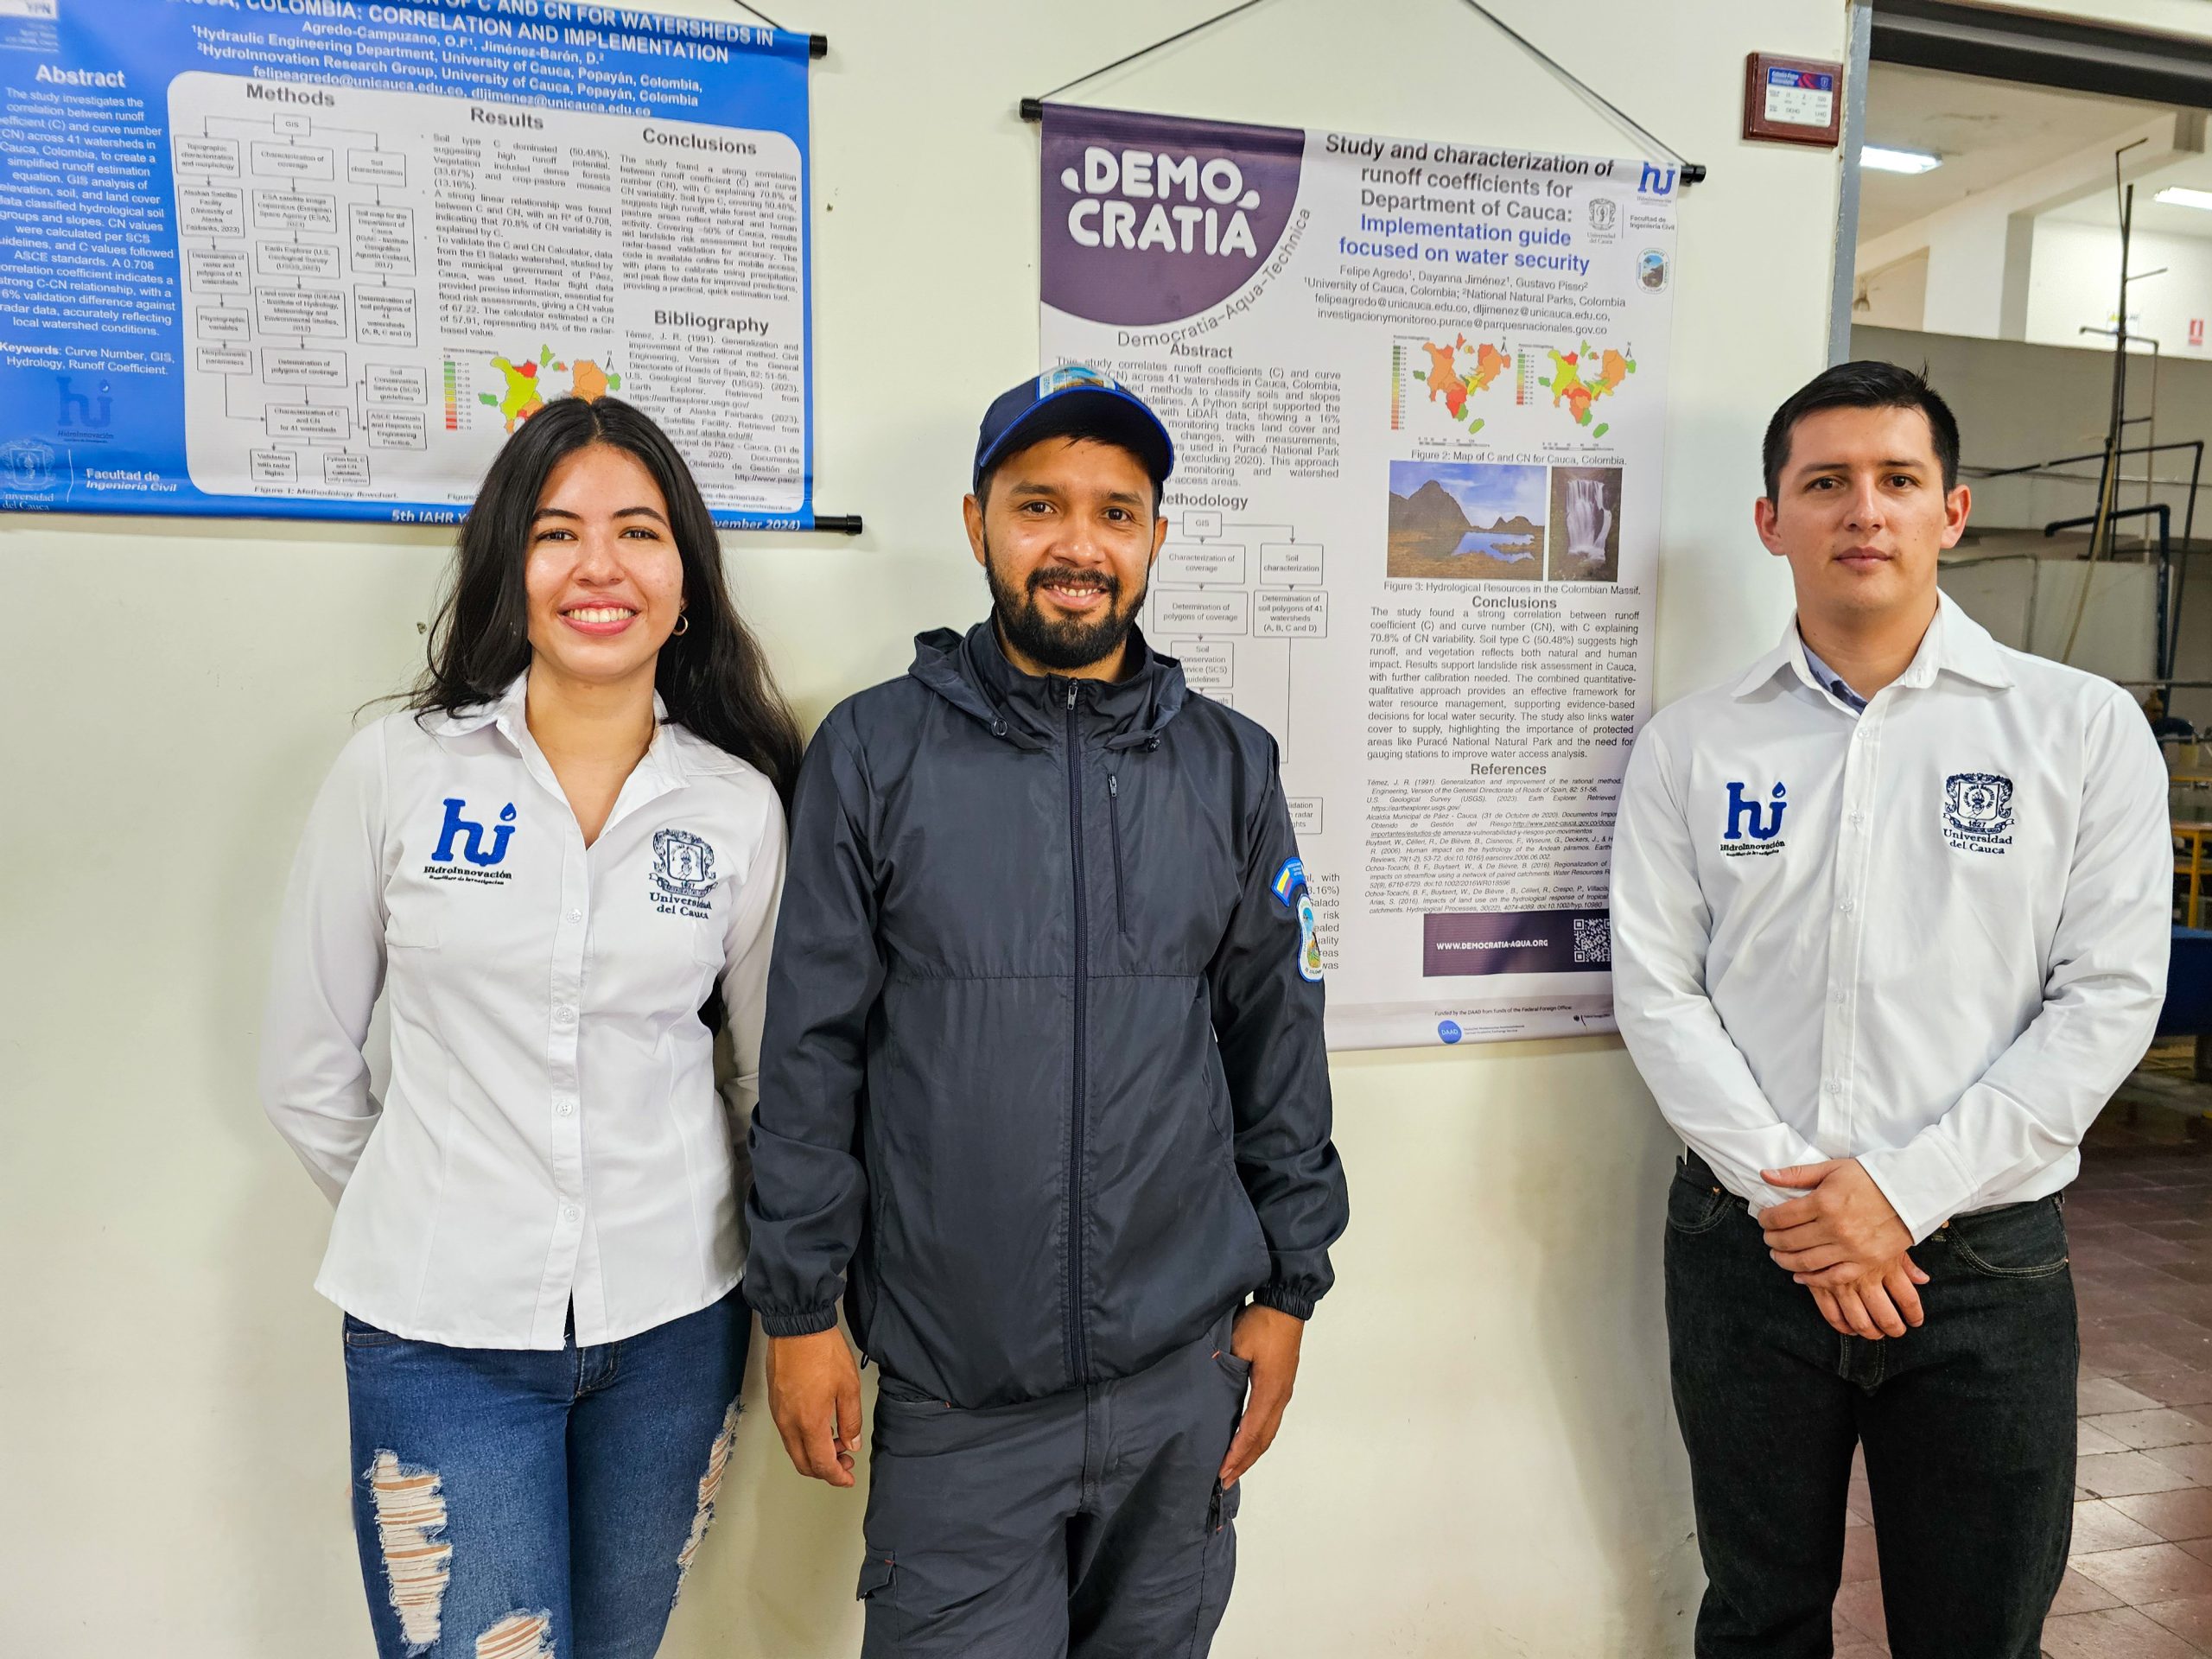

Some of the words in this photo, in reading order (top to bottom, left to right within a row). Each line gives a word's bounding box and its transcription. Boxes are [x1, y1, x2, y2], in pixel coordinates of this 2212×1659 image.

[498, 0, 538, 17] AND
[544, 3, 570, 20] CN
[577, 5, 616, 27] FOR
[620, 12, 750, 44] WATERSHEDS
[756, 28, 773, 47] IN
[368, 8, 512, 37] CORRELATION
[518, 23, 557, 42] AND
[564, 28, 728, 63] IMPLEMENTATION
[268, 33, 352, 55] Engineering
[356, 41, 437, 62] Department,
[442, 51, 509, 72] University
[512, 60, 526, 71] of
[530, 60, 574, 79] Cauca,
[578, 66, 636, 86] Popayán,
[639, 73, 702, 92] Colombia,
[35, 65, 126, 87] Abstract
[323, 54, 387, 72] Research
[391, 62, 436, 79] Group,
[442, 67, 508, 88] University
[512, 75, 525, 87] of
[529, 77, 573, 95] Cauca,
[577, 82, 635, 101] Popayán,
[639, 89, 697, 106] Colombia
[6, 87, 27, 99] The
[29, 92, 59, 104] study
[62, 95, 124, 107] investigates
[126, 97, 143, 107] the
[246, 83, 335, 107] Methods
[6, 104, 64, 115] correlation
[67, 107, 112, 119] between
[115, 111, 143, 121] runoff
[470, 106, 545, 130] Results
[642, 127, 758, 156] Conclusions
[1325, 134, 1384, 162] Study
[1390, 143, 1427, 160] and
[1433, 145, 1588, 175] characterization
[1593, 160, 1613, 176] of
[1084, 146, 1243, 205] DEMO
[1361, 167, 1422, 185] runoff
[1427, 171, 1539, 194] coefficients
[1546, 179, 1573, 197] for
[1361, 189, 1475, 214] Department
[1481, 200, 1500, 216] of
[1506, 200, 1571, 222] Cauca:
[1068, 199, 1258, 258] CRATIA
[1361, 213, 1511, 241] Implementation
[1518, 227, 1570, 247] guide
[1339, 236, 1417, 259] focused
[1425, 247, 1448, 262] on
[1455, 248, 1508, 265] water
[1515, 253, 1589, 276] security
[1117, 207, 1312, 347] Democratia-Aqua-Technica
[1339, 264, 1370, 278] Felipe
[1418, 270, 1461, 283] Dayanna
[1516, 277, 1555, 289] Gustavo
[1359, 281, 1369, 291] of
[1372, 282, 1407, 295] Cauca,
[1410, 285, 1459, 299] Colombia;
[1510, 291, 1543, 302] Natural
[1547, 293, 1575, 306] Parks,
[1579, 296, 1625, 307] Colombia
[1315, 292, 1470, 314] felipeagredo@unicauca.edu.co,
[1473, 303, 1610, 322] dljimenez@unicauca.edu.co,
[654, 310, 769, 337] Bibliography
[0, 342, 61, 355] Keywords:
[65, 346, 97, 357] Curve
[100, 348, 147, 361] Number,
[150, 352, 175, 364] GIS,
[1170, 344, 1233, 359] Abstract
[7, 356, 65, 370] Hydrology,
[69, 359, 105, 370] Runoff
[107, 362, 168, 375] Coefficient.
[1411, 448, 1439, 461] Figure
[1442, 451, 1451, 460] 2:
[1452, 451, 1473, 462] Map
[1475, 451, 1484, 461] of
[1487, 452, 1495, 461] C
[1497, 453, 1513, 461] and
[1516, 453, 1530, 462] CN
[1533, 454, 1544, 462] for
[1547, 454, 1578, 465] Cauca,
[1581, 455, 1626, 465] Colombia.
[86, 468, 141, 481] Facultad
[144, 471, 160, 481] de
[150, 481, 176, 492] Civil
[391, 509, 415, 522] 5th
[419, 511, 454, 523] IAHR
[766, 518, 800, 531] 2024)
[1383, 581, 1412, 592] Figure
[1426, 582, 1480, 593] Hydrological
[1484, 583, 1530, 592] Resources
[1544, 584, 1558, 593] the
[1560, 584, 1607, 594] Colombian
[1610, 585, 1640, 594] Massif.
[1471, 595, 1557, 609] Conclusions
[1370, 607, 1388, 615] The
[1397, 607, 1421, 618] study
[1429, 607, 1454, 617] found
[1478, 609, 1504, 620] strong
[1513, 609, 1560, 618] correlation
[1569, 609, 1605, 619] between
[1614, 610, 1639, 620] runoff
[1471, 763, 1547, 776] References
[1720, 840, 1785, 851] HidroInnovación
[1943, 829, 2012, 844] Universidad
[1950, 840, 1967, 849] del
[1969, 843, 2005, 854] Cauca
[423, 866, 512, 880] HidroInnovación
[650, 892, 712, 910] Universidad
[657, 905, 676, 914] del
[1436, 938, 1548, 950] WWW.DEMOCRATIA-AQUA.ORG
